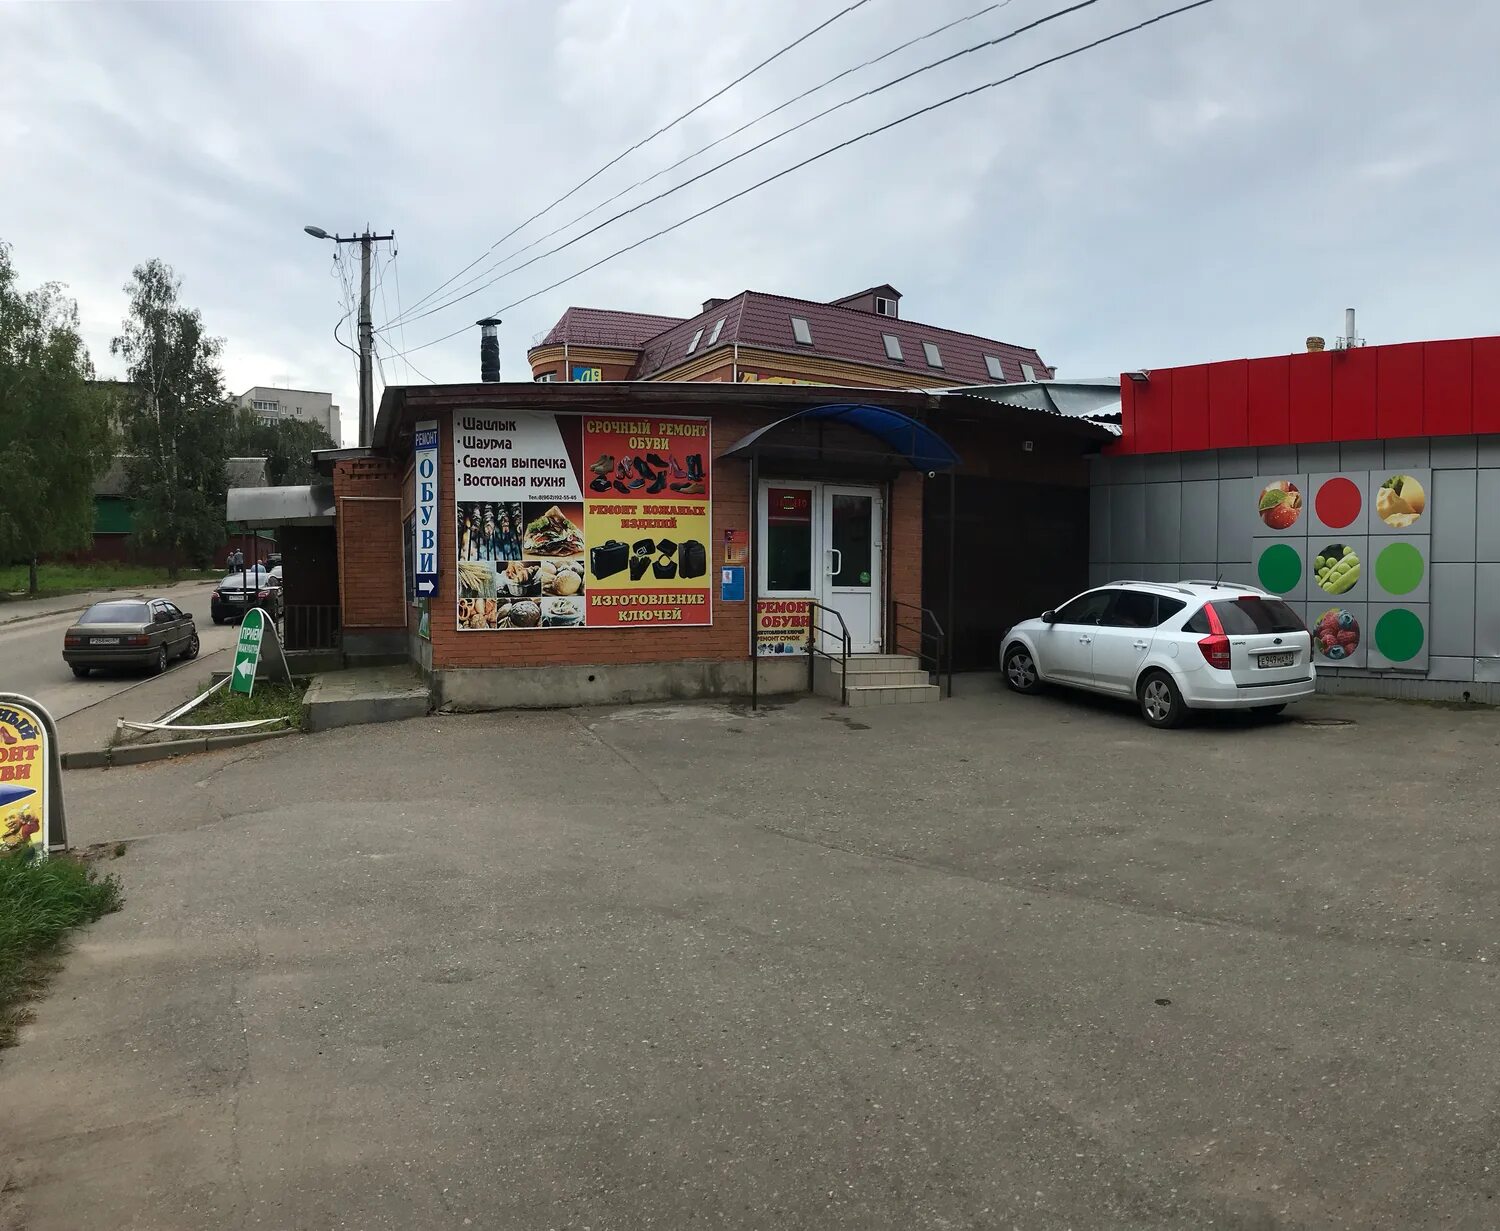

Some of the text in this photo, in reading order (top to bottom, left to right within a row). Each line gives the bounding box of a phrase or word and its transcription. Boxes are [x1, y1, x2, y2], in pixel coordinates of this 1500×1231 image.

[587, 420, 707, 437] СРОЧНЫЙ РЕМОНТ
[416, 431, 437, 447] РЕМОНТ
[463, 436, 512, 450] Шаурма
[629, 437, 669, 450] ОБУВИ
[511, 458, 566, 469] выпечка
[530, 476, 566, 487] кухня
[420, 459, 434, 572] ОБУВИ
[589, 505, 706, 516] РЕМОНТ КОЖАНЫХ
[621, 517, 677, 530] ИЗДЕЛИЙ
[591, 594, 705, 606] ИЗГОТОВЛЕНИЕ
[618, 608, 682, 621] КЛЮЧЕЙ
